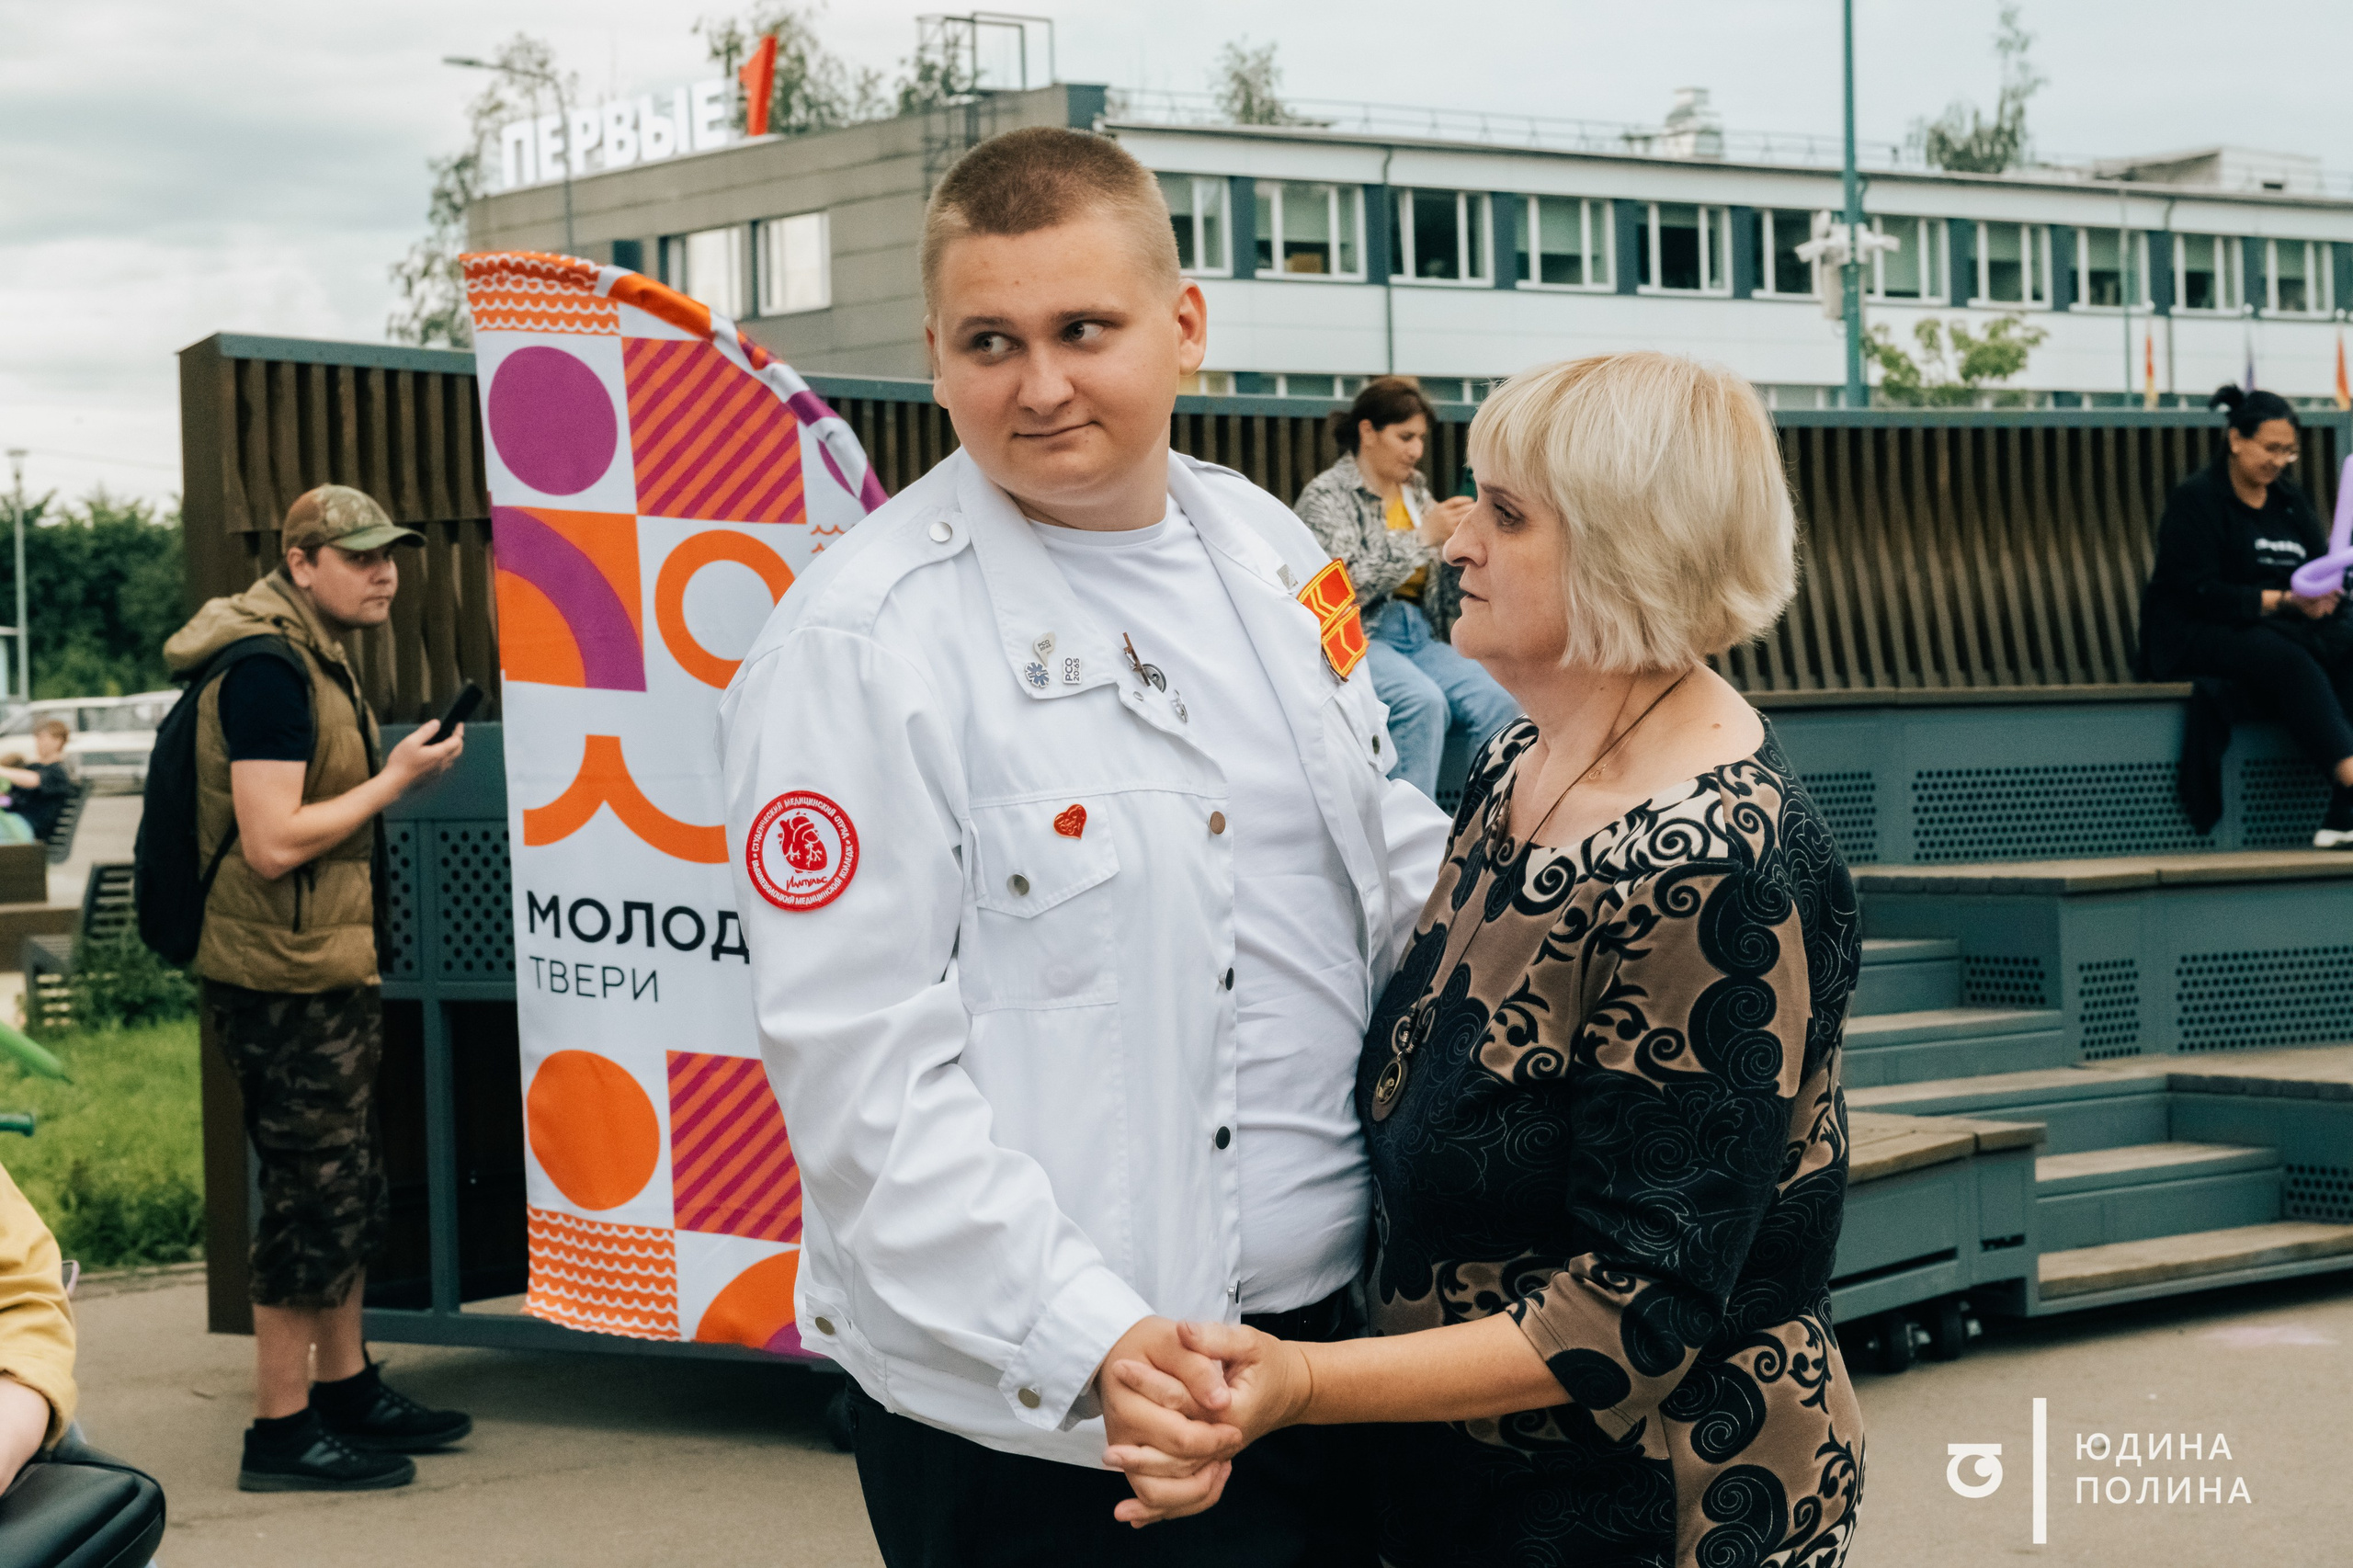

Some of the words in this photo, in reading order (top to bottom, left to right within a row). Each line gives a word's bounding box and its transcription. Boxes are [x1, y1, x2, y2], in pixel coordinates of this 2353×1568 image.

[501, 79, 730, 190] ПЕРВЫЕ
[784, 797, 836, 817] МЕДИЦИНСКИЙ
[834, 815, 849, 839] ОТРЯД
[795, 877, 843, 905] МЕДИЦИНСКИЙ
[527, 890, 750, 965] МОЛОД
[529, 955, 658, 1003] ТВЕРИ
